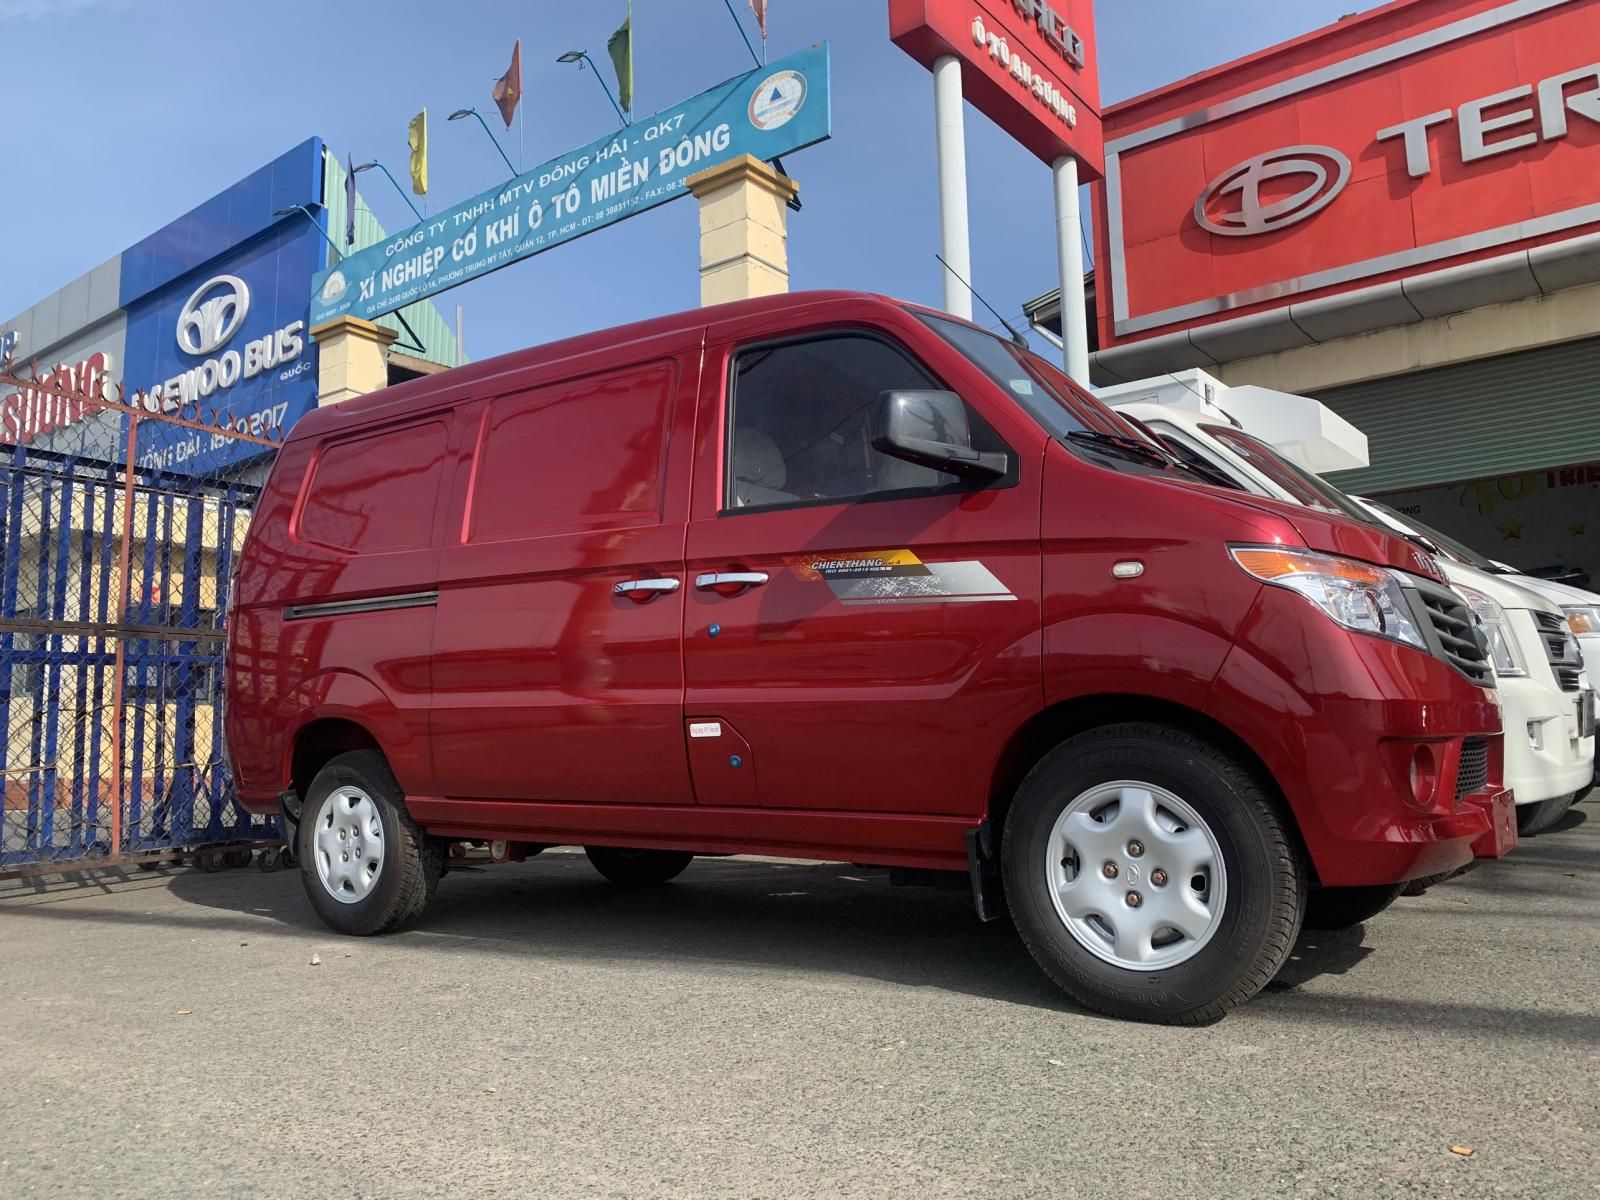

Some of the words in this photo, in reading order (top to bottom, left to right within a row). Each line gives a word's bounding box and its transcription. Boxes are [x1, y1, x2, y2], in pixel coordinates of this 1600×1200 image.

[971, 15, 986, 45] Ô
[985, 32, 1010, 66] TÔ
[1009, 53, 1032, 86] AN
[1376, 62, 1600, 177] TER
[359, 270, 375, 302] XÍ
[381, 245, 445, 292] NGHIỆP
[452, 225, 477, 262] CƠ
[485, 205, 520, 248] KHÍ
[528, 199, 543, 229] Ô
[551, 182, 581, 219] TÔ
[591, 156, 649, 204] MIỀN
[658, 123, 731, 175] ĐÔNG
[385, 231, 424, 256] CÔNG
[428, 219, 447, 237] TY
[453, 198, 495, 226] TNHH
[499, 179, 534, 206] MTV
[538, 156, 590, 188] ĐÔNG
[644, 114, 685, 140] QK7
[465, 258, 486, 273] TRUNG
[559, 221, 576, 235] HCM
[645, 186, 665, 200] FAX:
[243, 320, 303, 378] BUS
[280, 361, 311, 381] QUỐC
